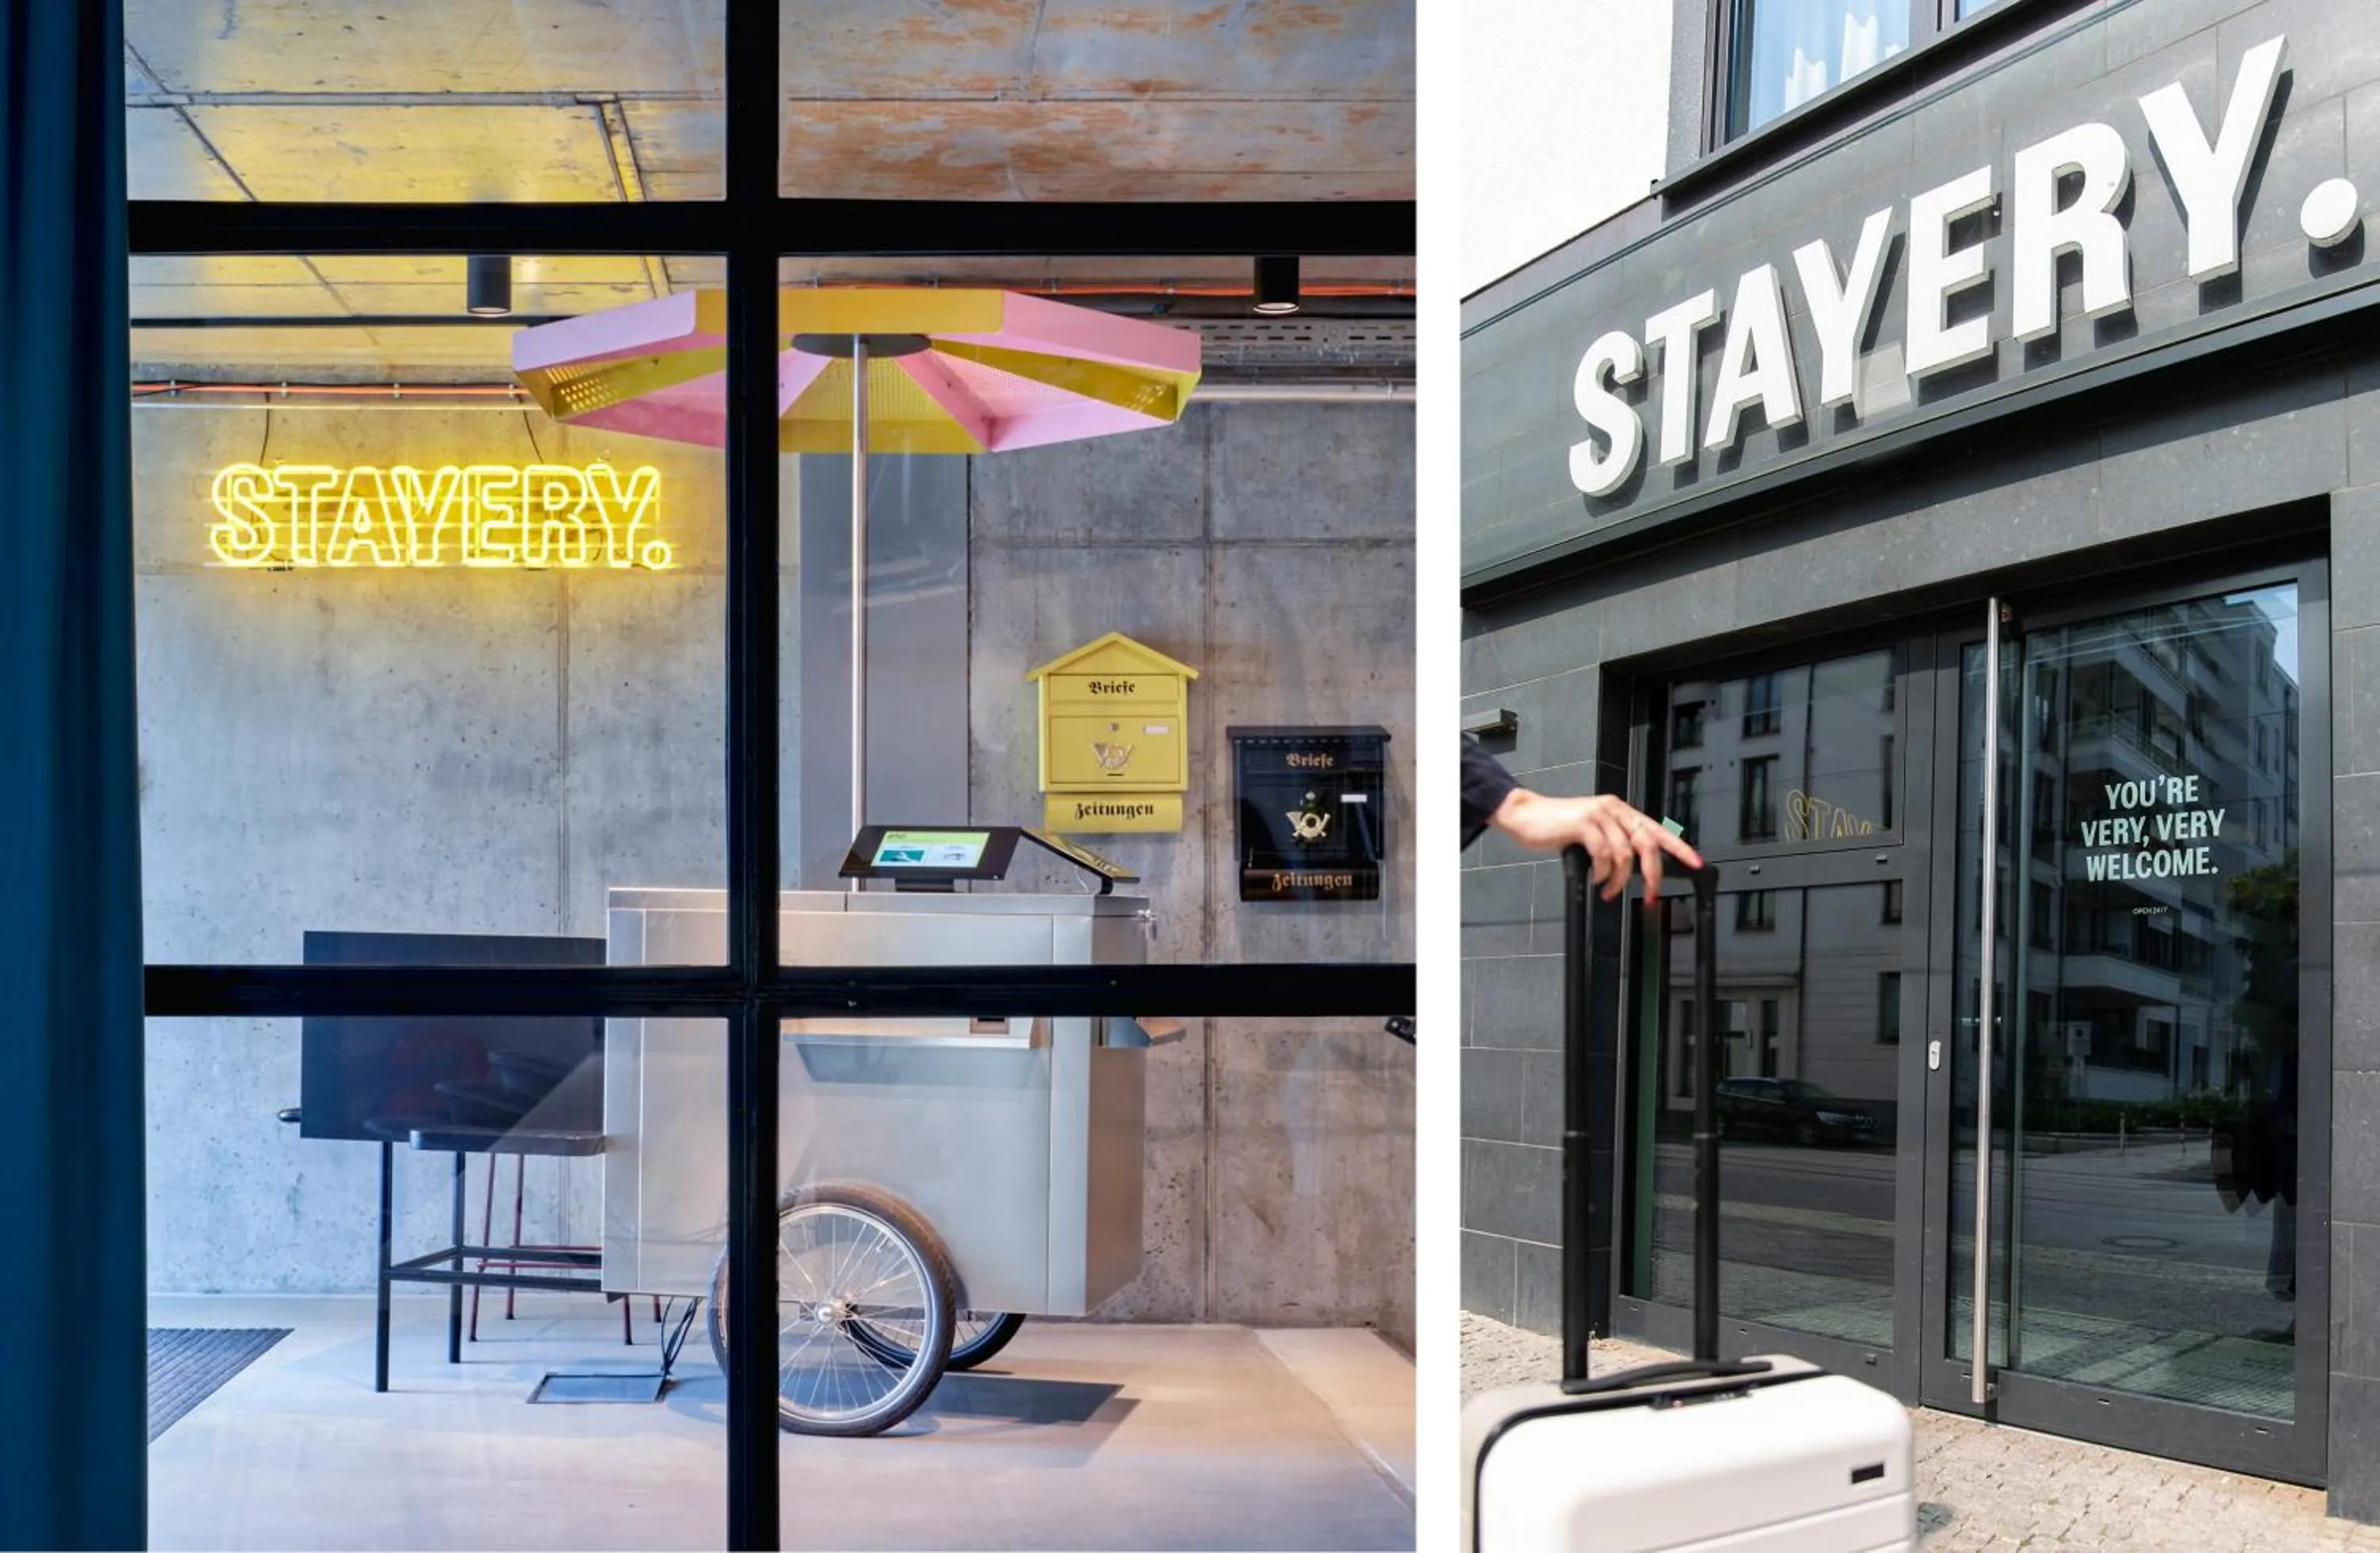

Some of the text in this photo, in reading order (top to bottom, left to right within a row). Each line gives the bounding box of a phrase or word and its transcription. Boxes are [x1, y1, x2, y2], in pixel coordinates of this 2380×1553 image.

[1568, 33, 2360, 497] STAYERY.
[209, 462, 672, 570] STAYERY.
[1088, 680, 1136, 695] Briefe
[1285, 752, 1334, 769] Briefe
[1075, 801, 1154, 819] Zeitungen
[2105, 774, 2199, 810] YOU'RE
[2081, 808, 2225, 847] VERY, VERY
[1272, 872, 1352, 892] Zeitungen
[2086, 846, 2219, 882] WELCOME.
